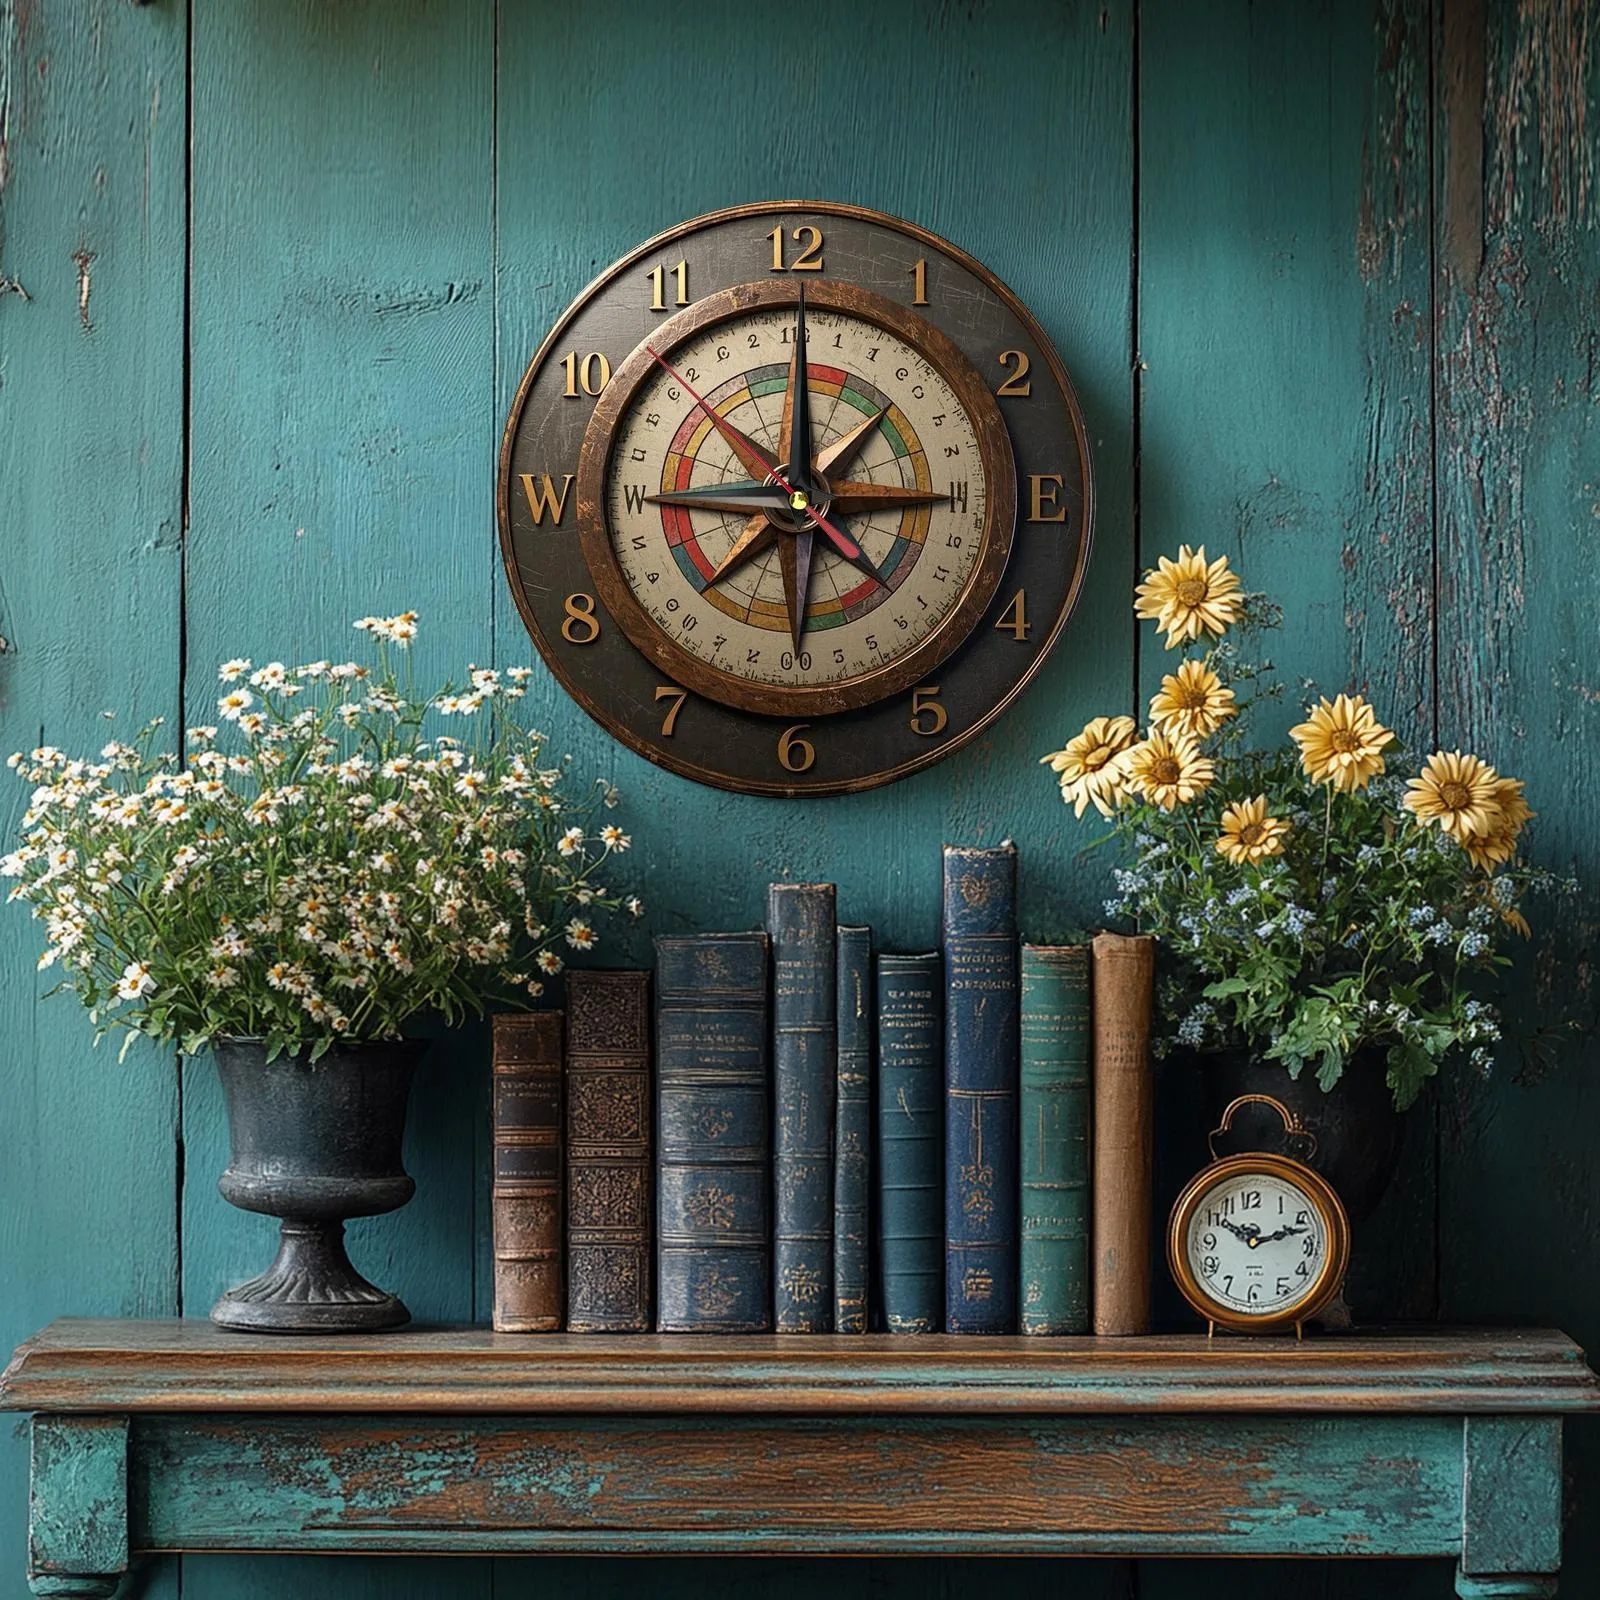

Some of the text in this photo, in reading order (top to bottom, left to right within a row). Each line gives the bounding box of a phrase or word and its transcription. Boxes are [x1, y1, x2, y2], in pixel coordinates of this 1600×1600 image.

[767, 225, 823, 272] 12
[647, 260, 691, 311] 11
[908, 258, 929, 304] 1
[559, 351, 612, 398] 10
[997, 350, 1030, 397] 2
[519, 473, 575, 526] W
[624, 484, 646, 514] W
[1027, 473, 1066, 523] E
[561, 593, 601, 644] 8
[995, 588, 1031, 641] 4
[655, 686, 689, 737] 7
[910, 687, 947, 735] 5
[778, 724, 815, 772] 6
